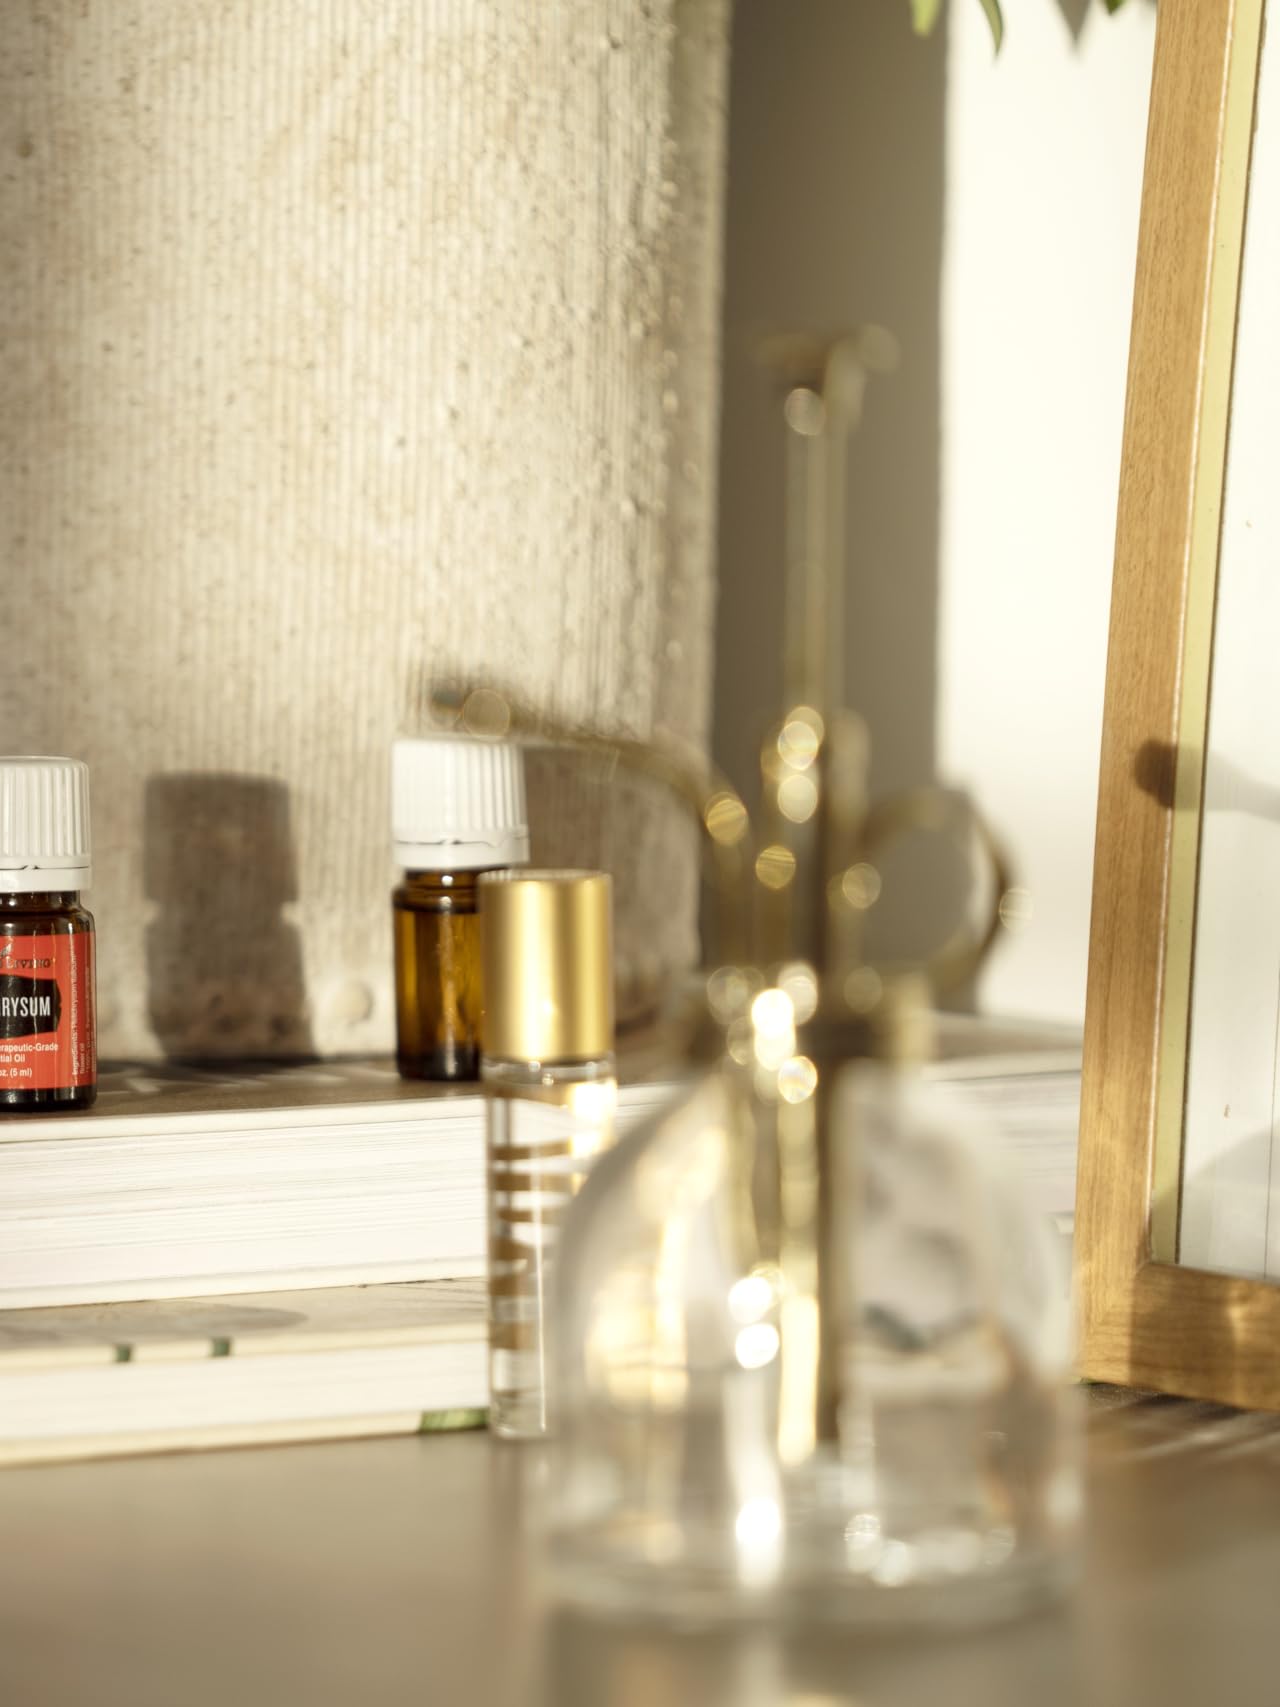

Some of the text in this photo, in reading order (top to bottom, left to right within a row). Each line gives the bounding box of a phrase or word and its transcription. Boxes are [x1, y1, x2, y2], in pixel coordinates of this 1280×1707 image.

[6, 955, 51, 968] LIVING
[14, 1053, 26, 1063] Oil
[9, 1067, 18, 1078] (5
[19, 1067, 32, 1078] ml)
